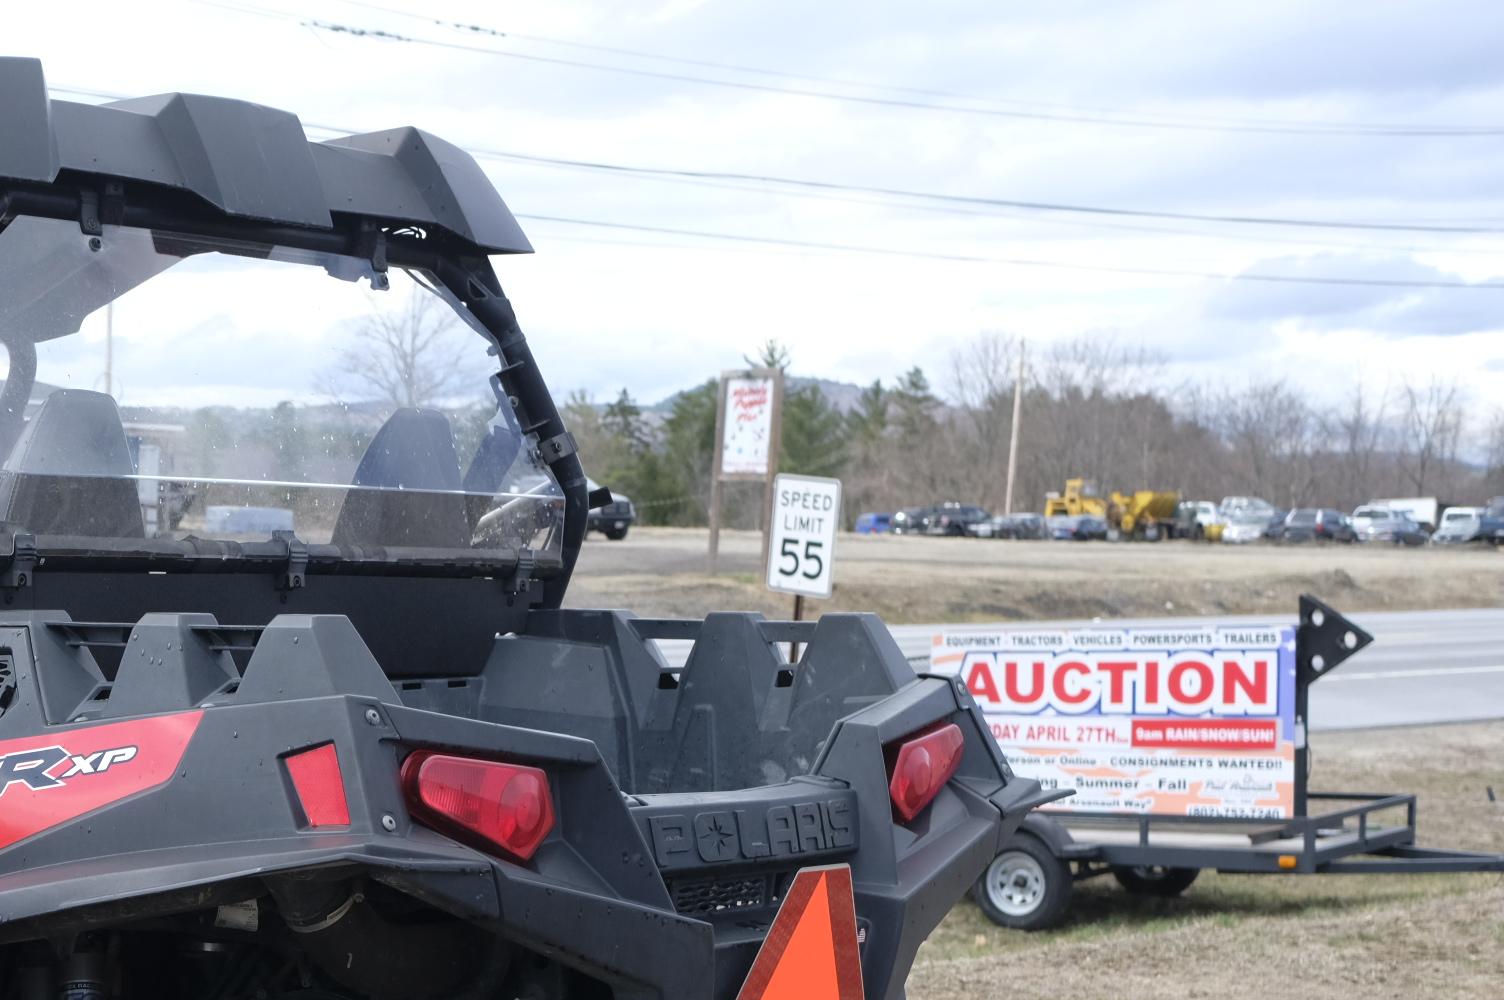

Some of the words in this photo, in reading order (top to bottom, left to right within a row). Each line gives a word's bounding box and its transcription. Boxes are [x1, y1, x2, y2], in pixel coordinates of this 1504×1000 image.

[781, 490, 832, 511] SPEED
[784, 516, 824, 534] LIMIT
[779, 538, 822, 580] 55
[946, 635, 1000, 647] EQUIPMENT
[1012, 635, 1063, 646] TRACTORS
[1073, 634, 1122, 646] VEHICLES
[1133, 634, 1212, 645] POWERSPORTS
[1224, 633, 1277, 644] TRAILERS
[966, 661, 1268, 705] AUCTION
[1026, 726, 1071, 742] APRIL
[1077, 727, 1116, 742] 27TH
[1136, 727, 1164, 742] 9am
[61, 746, 138, 778] XP
[1060, 755, 1097, 766] Online
[1110, 757, 1214, 769] CONSIGNMENTS
[1075, 777, 1139, 789] Summer
[1158, 779, 1187, 790] Fall
[649, 799, 855, 868] POLARIS
